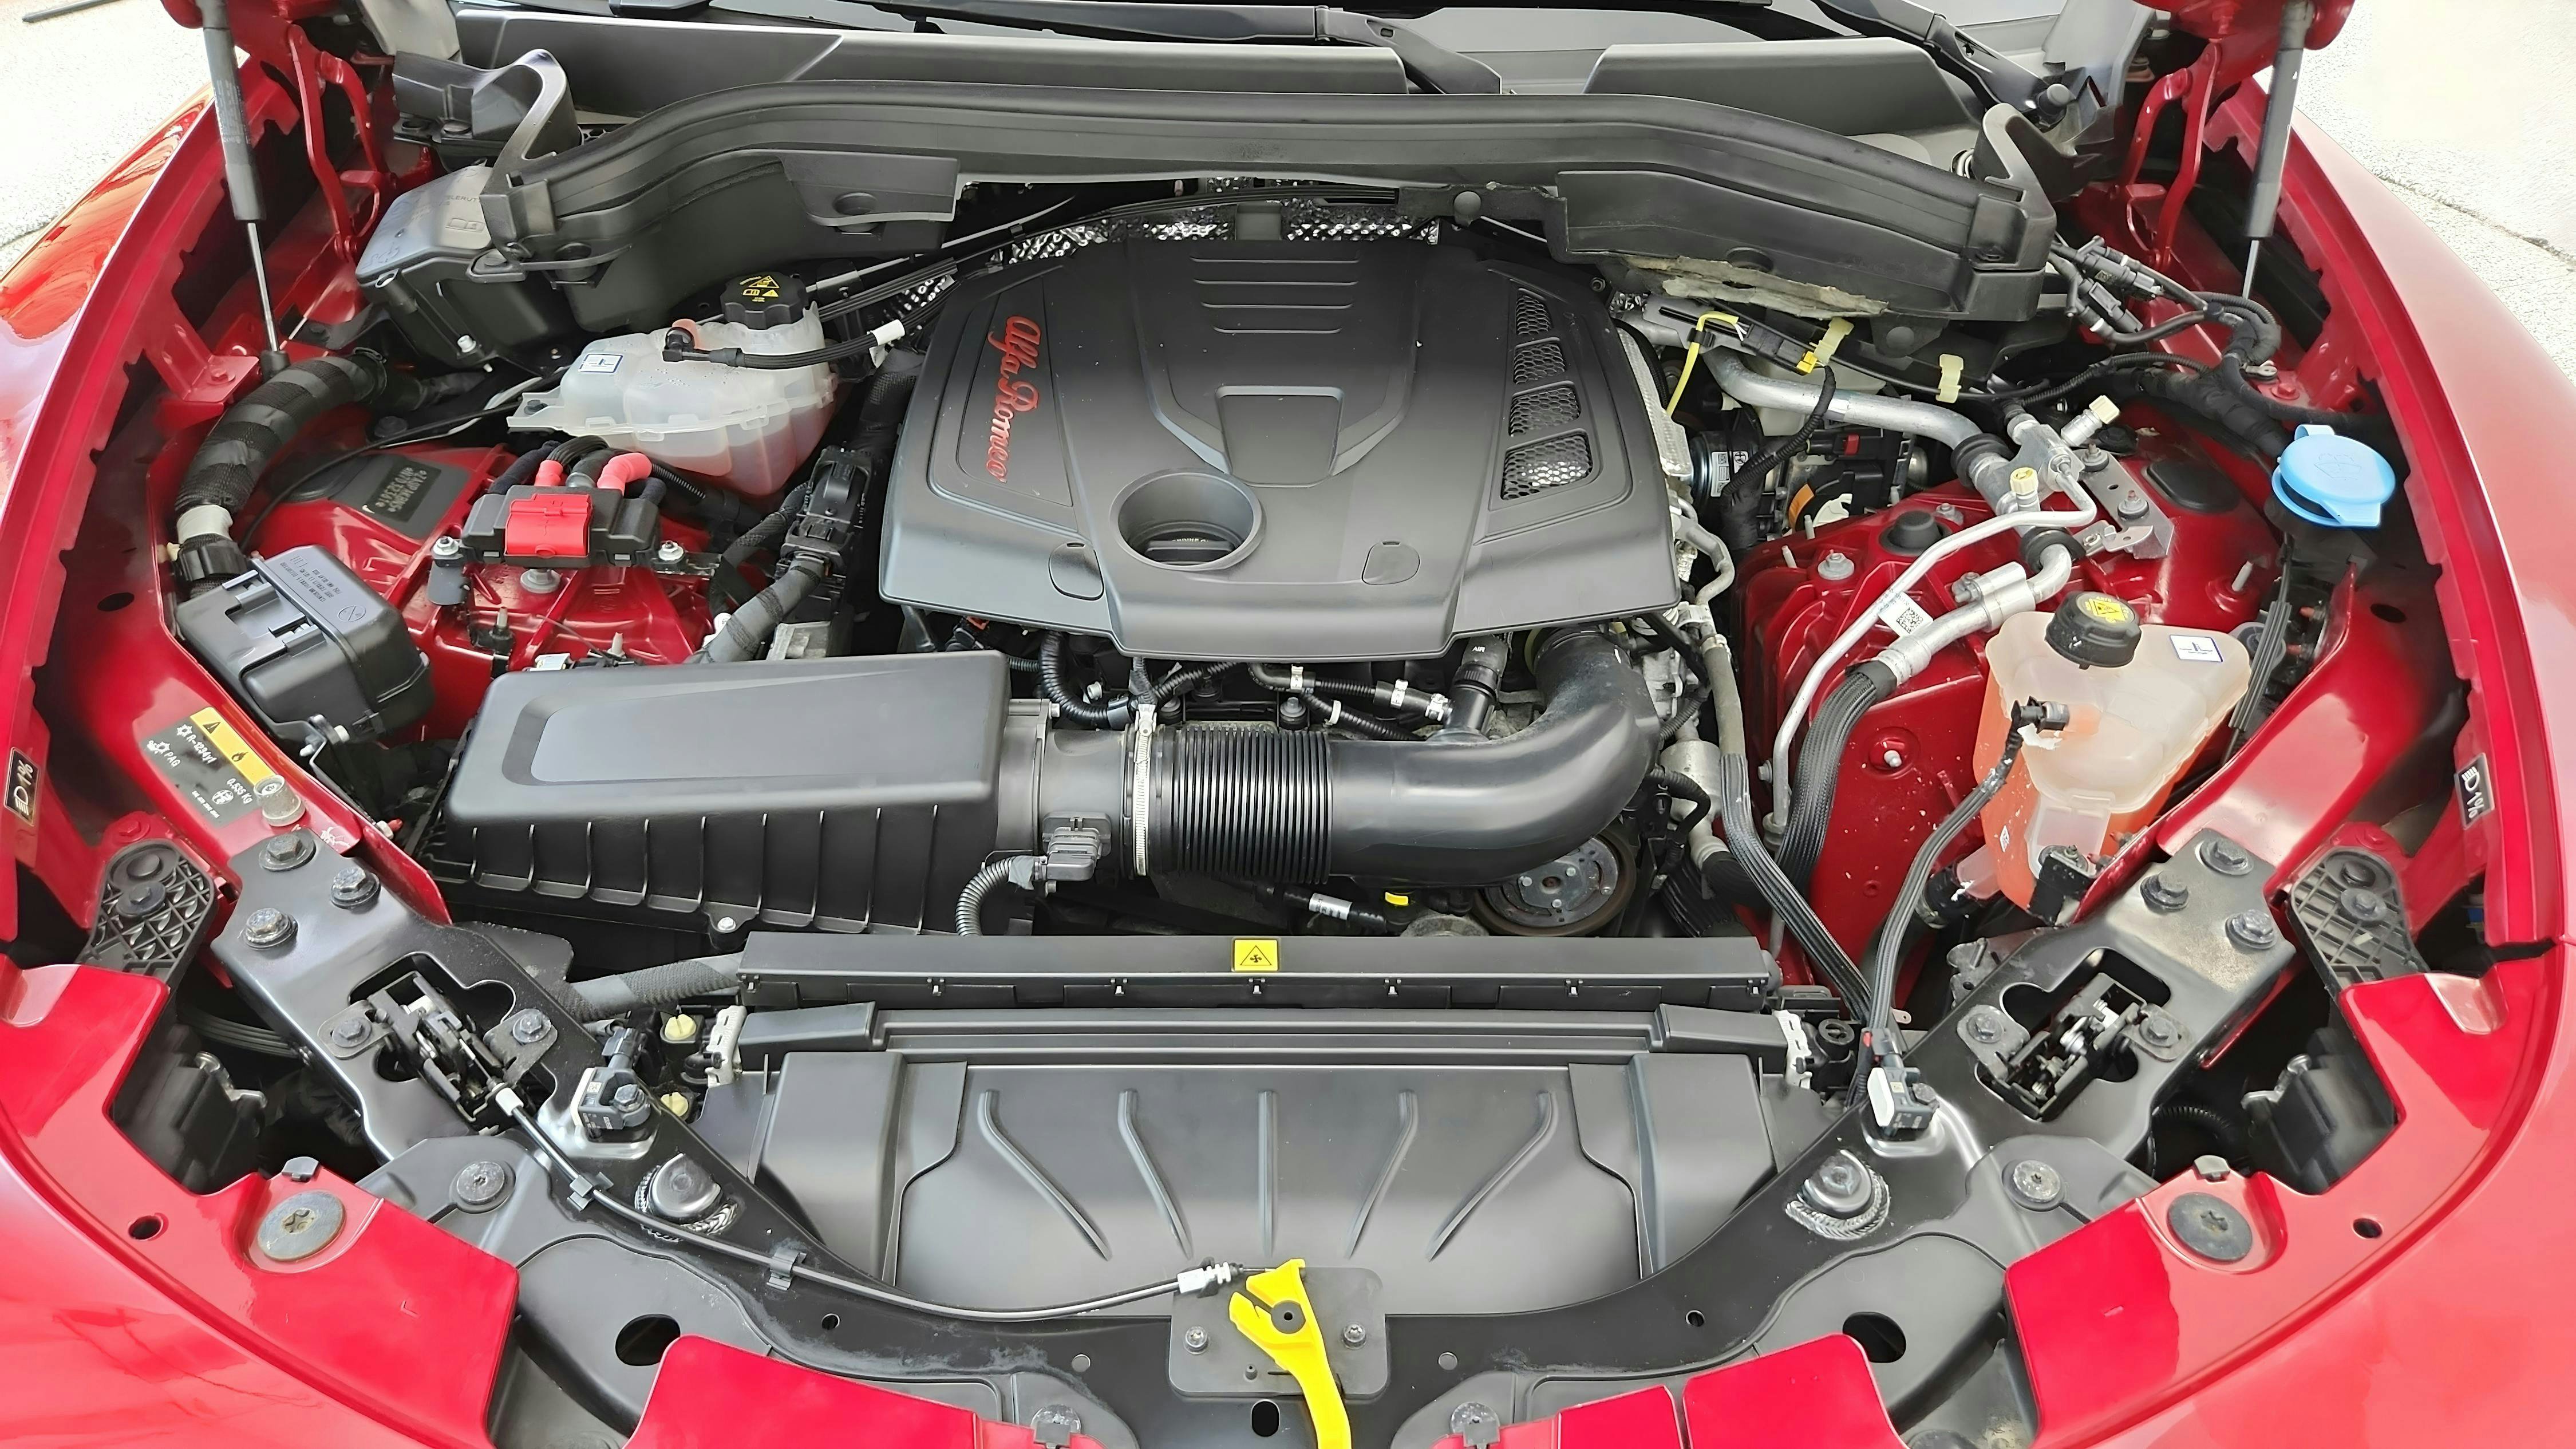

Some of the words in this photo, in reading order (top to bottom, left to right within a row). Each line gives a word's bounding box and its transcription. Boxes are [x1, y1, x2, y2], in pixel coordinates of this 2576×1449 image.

[987, 315, 1041, 380] Alfa
[986, 378, 1039, 483] Romeo
[17, 759, 33, 786] 1%
[164, 751, 181, 768] PAG
[241, 792, 253, 804] Kg
[2467, 791, 2484, 819] 1%
